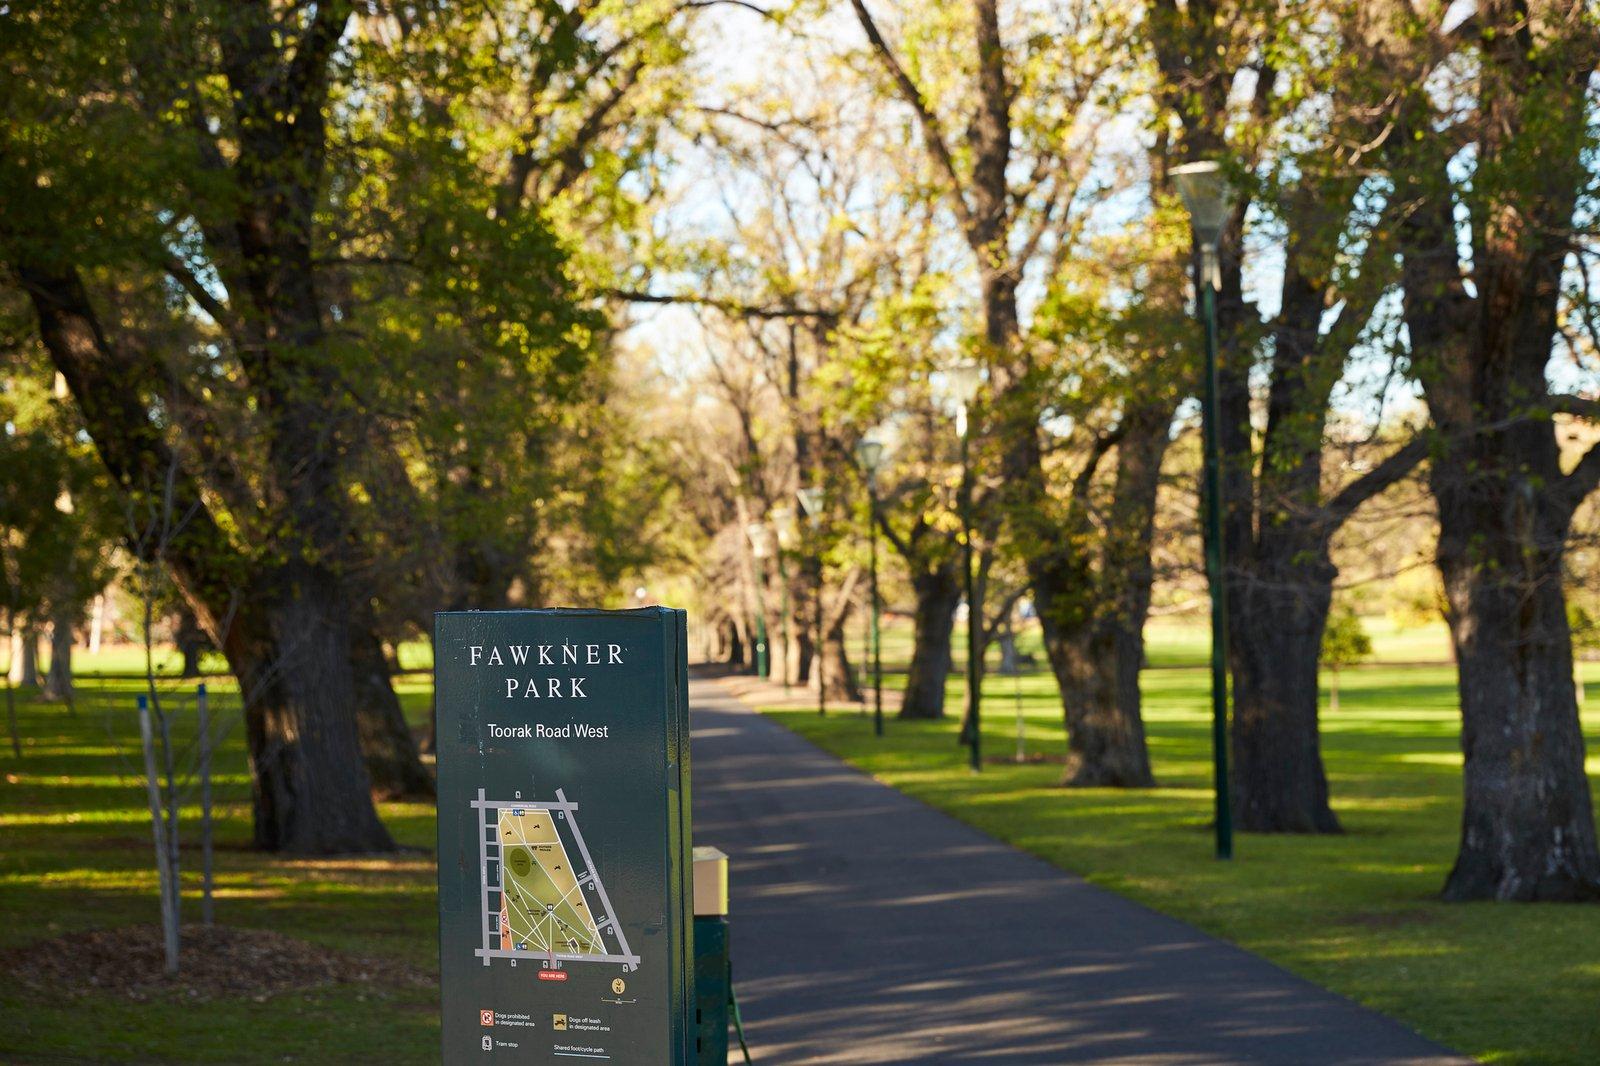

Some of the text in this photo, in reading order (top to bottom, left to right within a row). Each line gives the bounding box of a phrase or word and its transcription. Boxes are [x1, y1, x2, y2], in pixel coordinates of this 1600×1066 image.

[470, 644, 624, 666] FAWKNER
[506, 677, 588, 698] PARK
[488, 723, 609, 738] Toorak Road West
[495, 1012, 507, 1020] Dogs
[569, 1016, 581, 1024] Dogs
